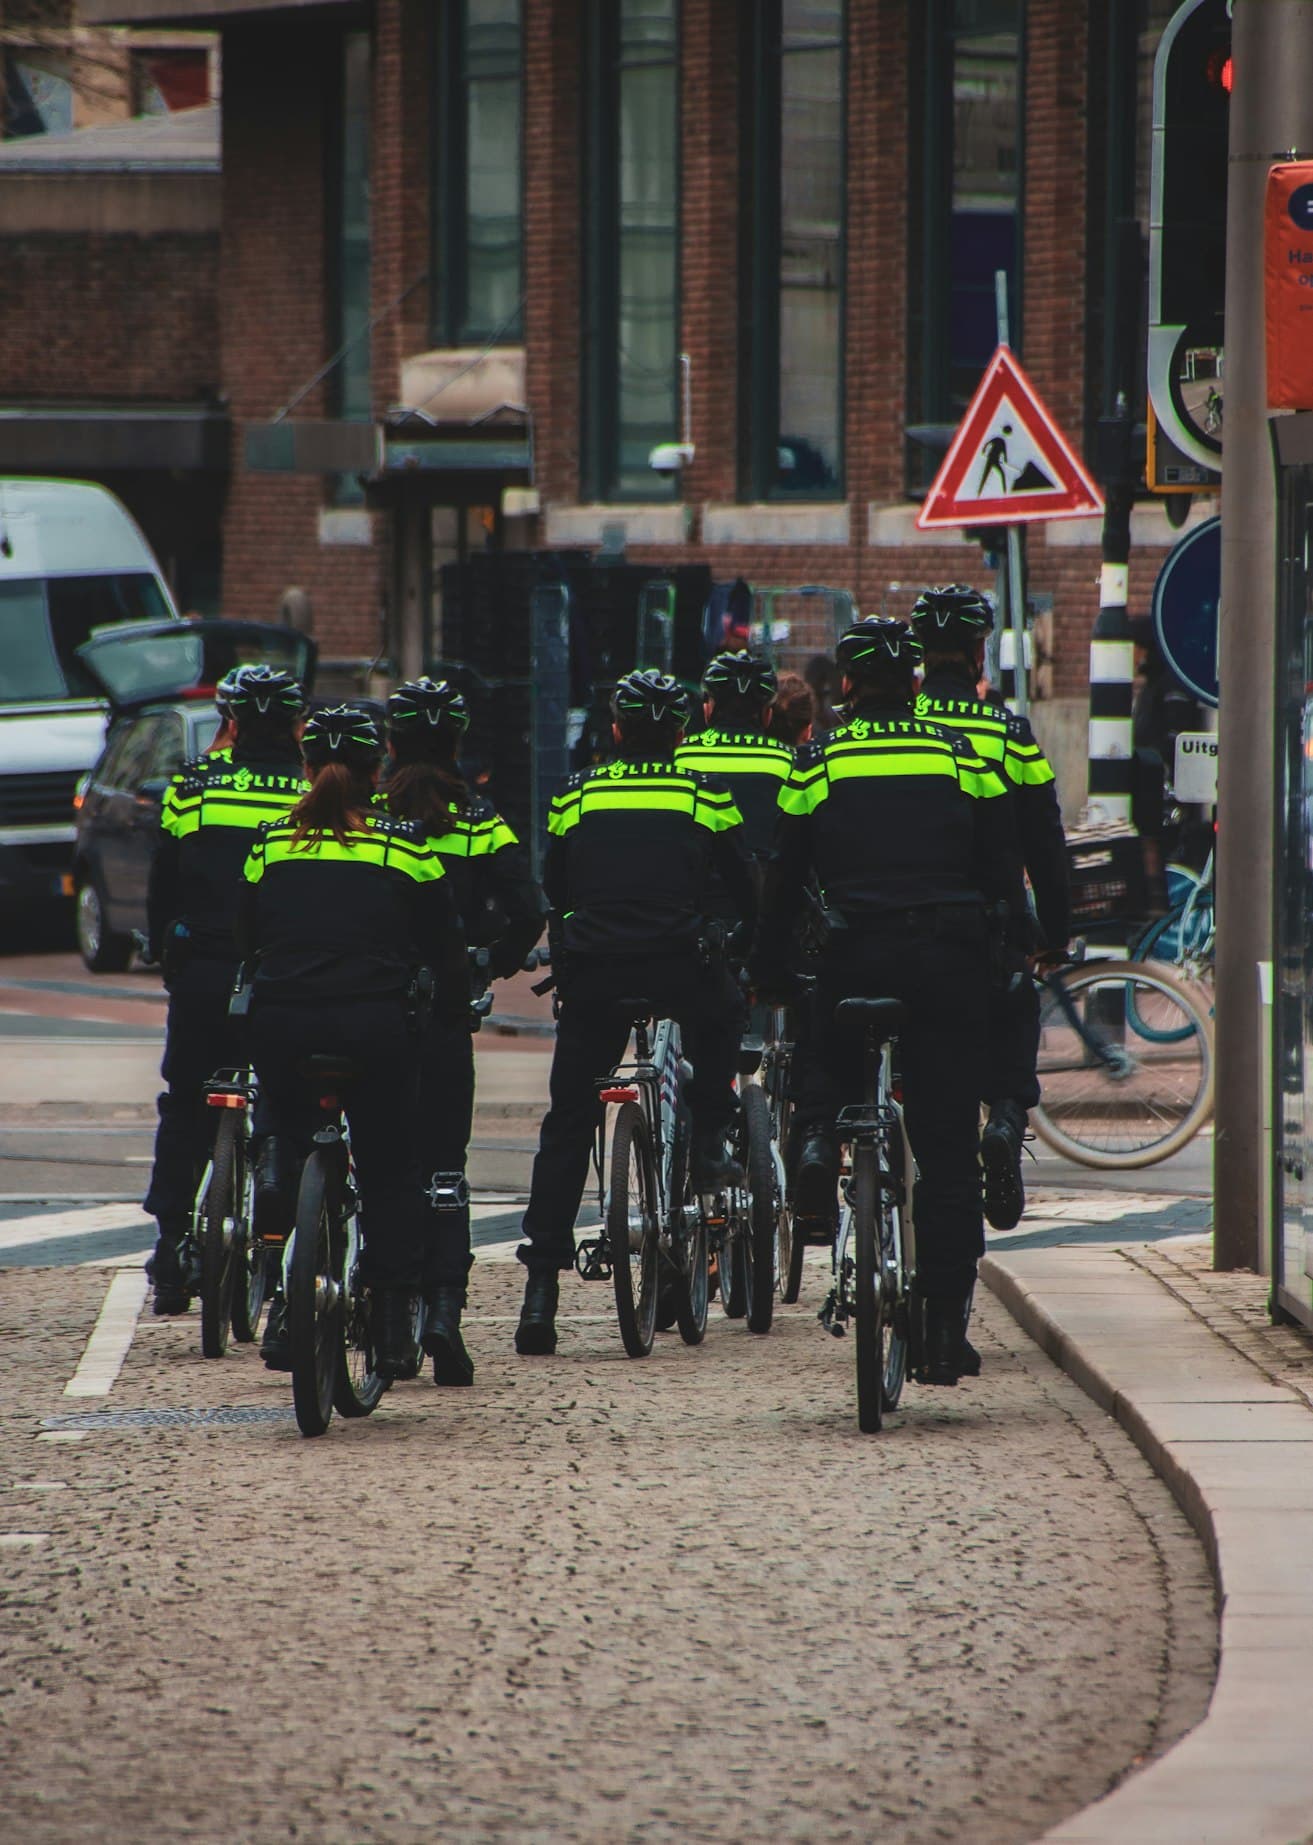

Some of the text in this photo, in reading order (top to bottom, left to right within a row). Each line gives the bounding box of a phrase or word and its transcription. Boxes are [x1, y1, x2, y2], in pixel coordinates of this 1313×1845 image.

[913, 692, 993, 717] OLITIE
[688, 727, 778, 747] POLITIE
[835, 717, 937, 740] POLITIE
[596, 759, 686, 779] POLITIE
